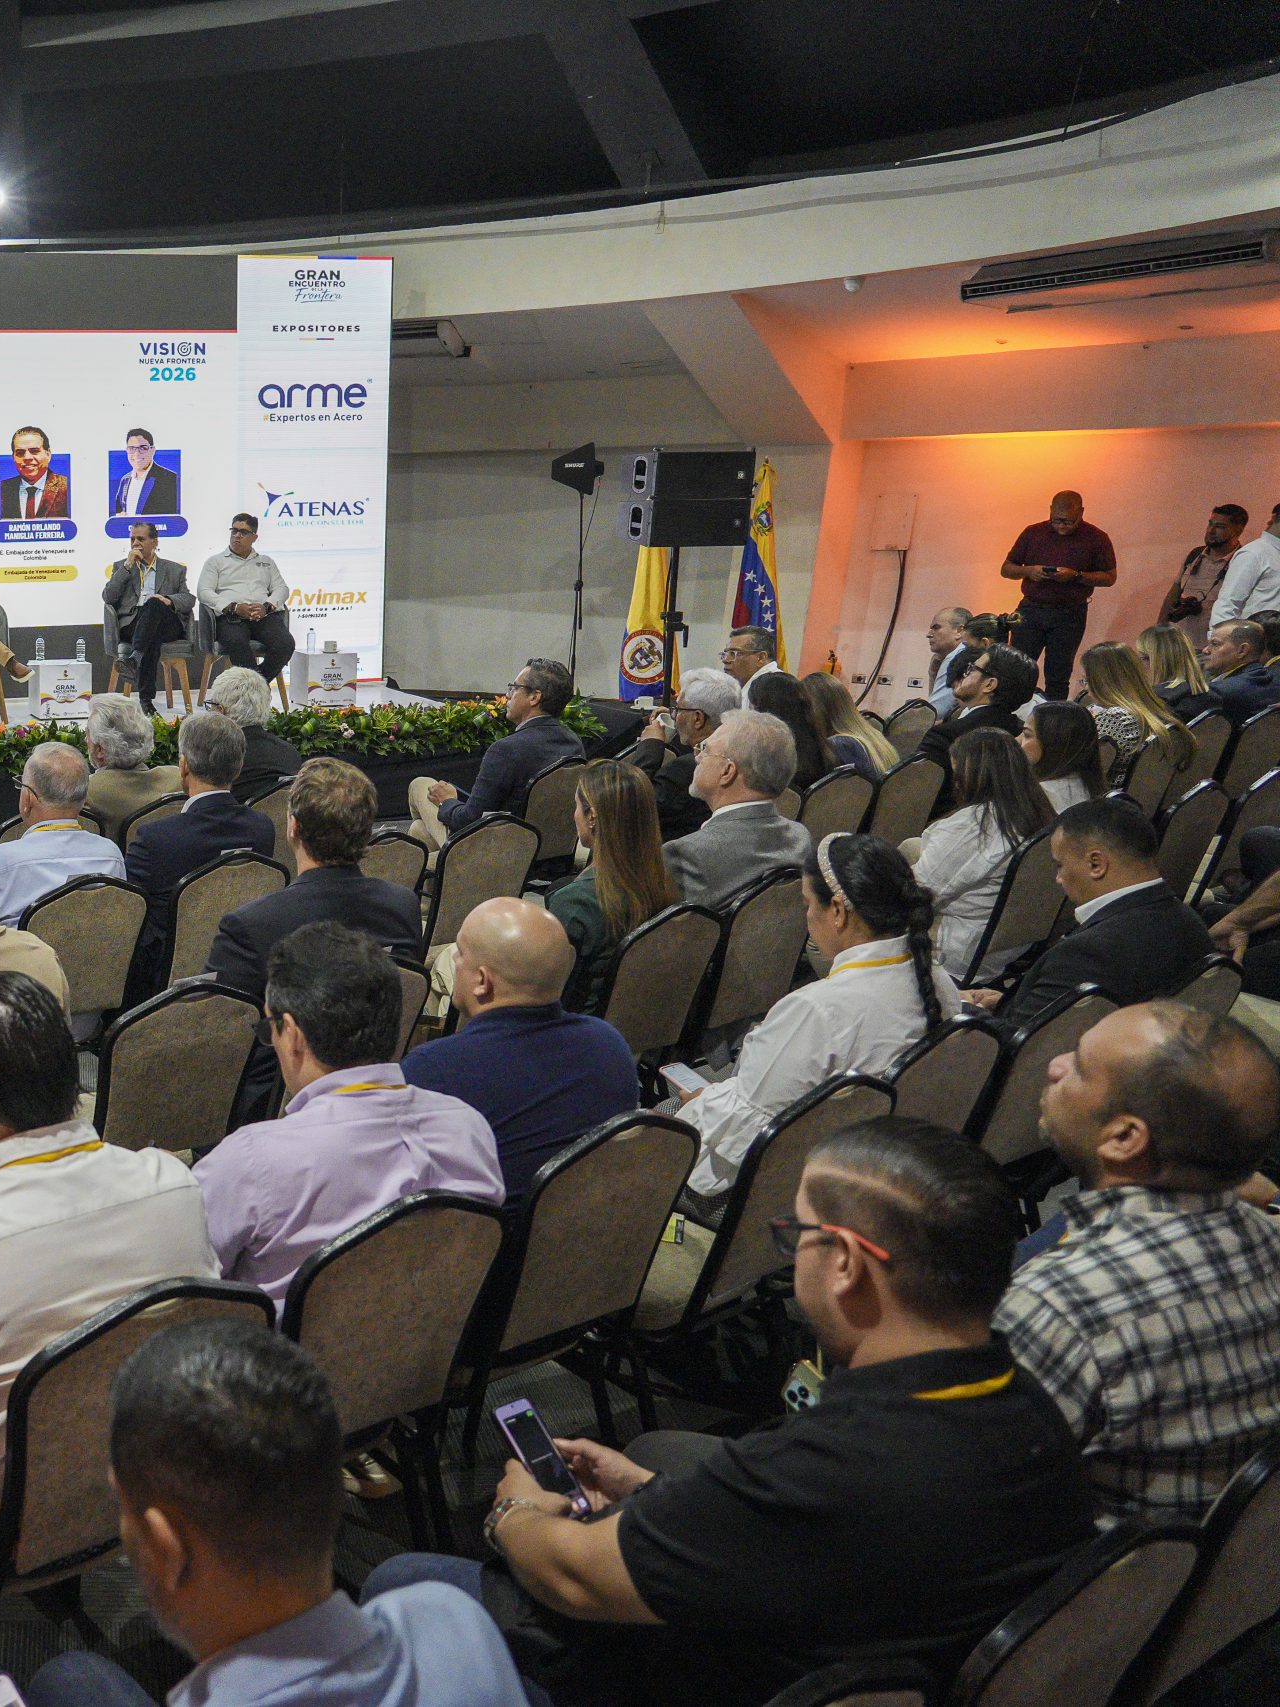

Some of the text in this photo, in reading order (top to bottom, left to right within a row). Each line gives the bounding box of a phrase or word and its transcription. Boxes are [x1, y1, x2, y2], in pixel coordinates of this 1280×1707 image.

[294, 269, 341, 281] GRAN
[288, 280, 346, 288] ENCUENTRO
[294, 287, 343, 302] Frontera
[272, 325, 361, 333] EXPOSITORES
[149, 367, 197, 382] 2026
[258, 383, 368, 409] arme
[318, 414, 331, 422] en
[333, 412, 363, 421] Acero
[278, 500, 365, 518] ATENAS
[8, 523, 61, 532] RAMÓN ORLANDO
[4, 531, 65, 540] MANIGLIA FERREIRA
[287, 588, 367, 606] Avimax
